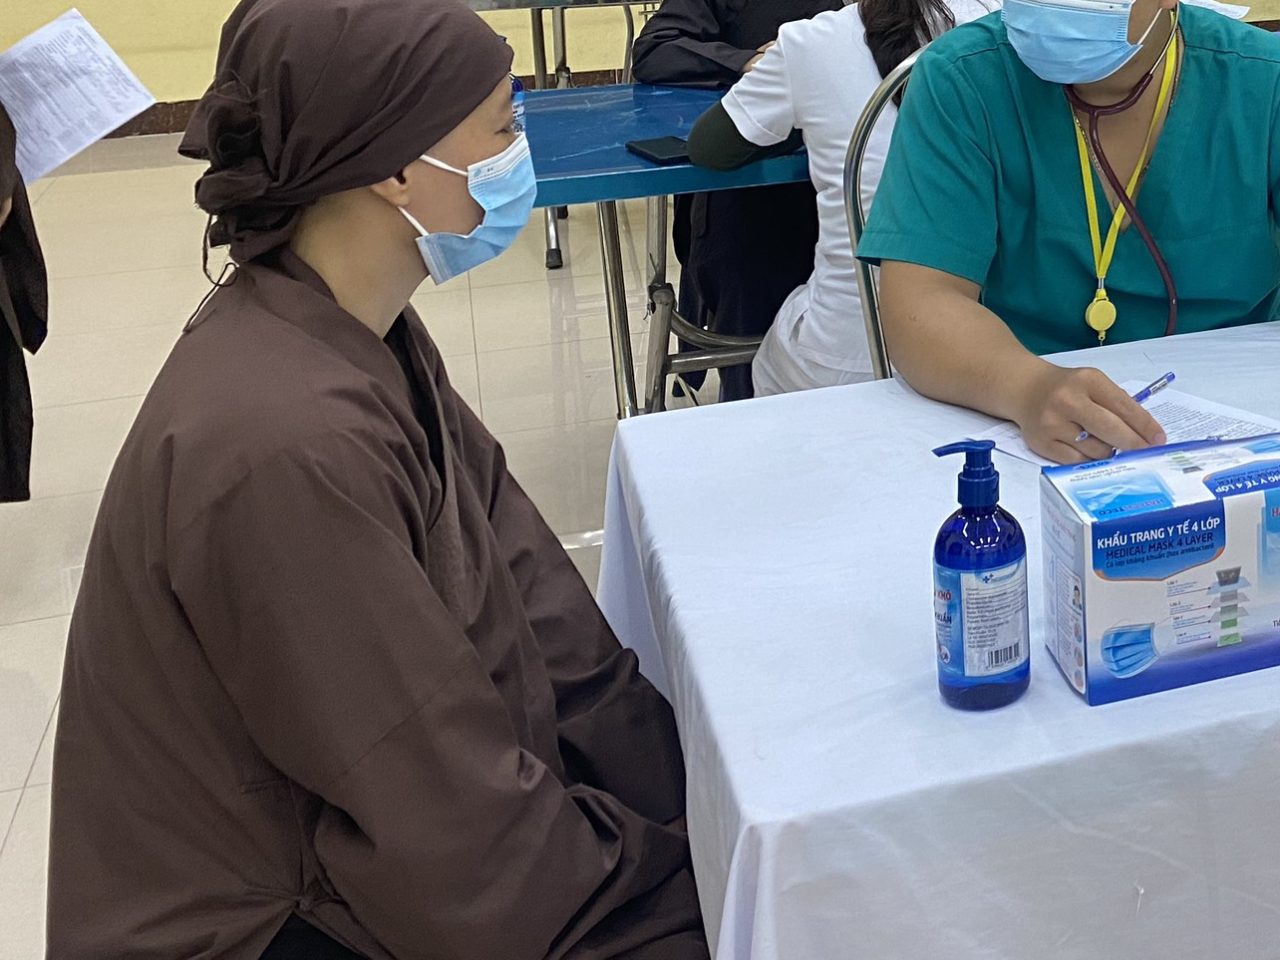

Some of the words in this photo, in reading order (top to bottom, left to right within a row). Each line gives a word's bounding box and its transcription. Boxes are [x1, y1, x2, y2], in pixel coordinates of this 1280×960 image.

[1097, 531, 1128, 549] KHẨU
[1130, 528, 1165, 543] TRANG
[1167, 526, 1175, 537] Y
[1177, 519, 1190, 534] TẾ
[1191, 522, 1199, 532] 4
[1200, 516, 1221, 531] LỚP
[1105, 546, 1146, 560] MEDICAL
[1148, 541, 1174, 553] MASK
[1176, 538, 1183, 546] 4
[1185, 532, 1214, 545] LAYER
